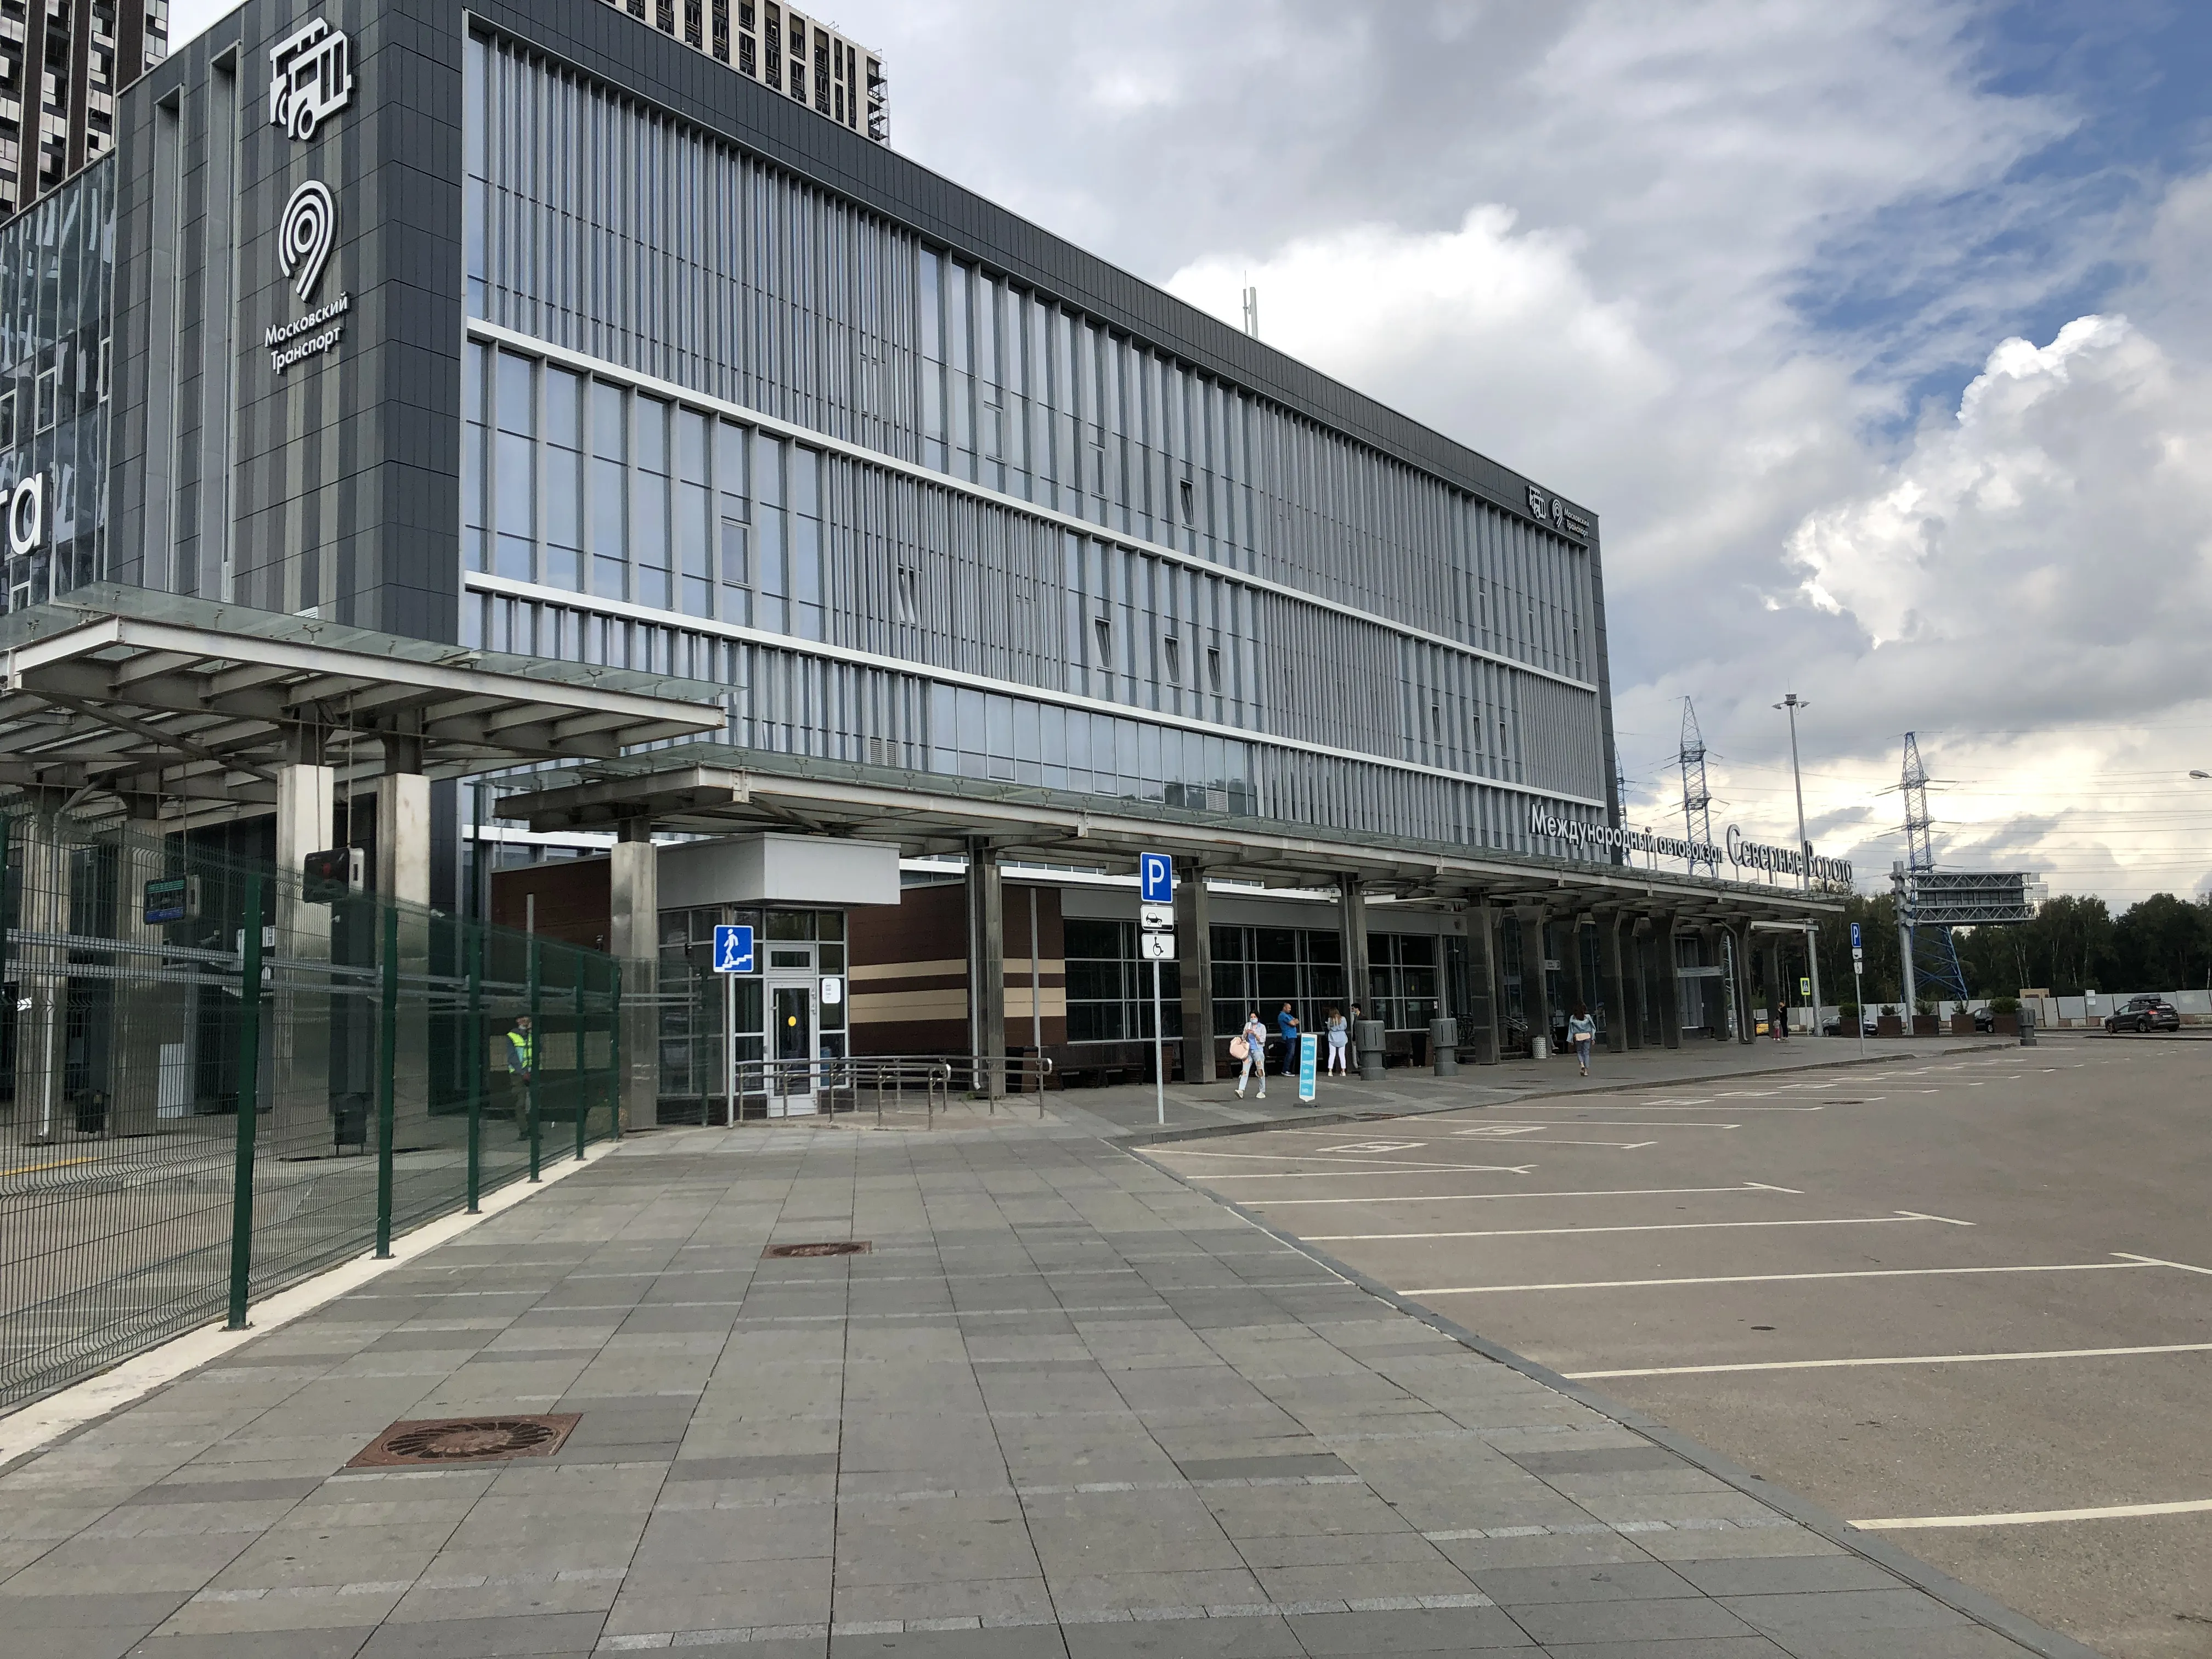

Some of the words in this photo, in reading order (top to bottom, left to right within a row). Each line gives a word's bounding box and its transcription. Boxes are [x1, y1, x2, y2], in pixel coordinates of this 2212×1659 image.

[265, 291, 348, 347] Московский
[270, 327, 340, 375] Транспорт
[1531, 804, 1656, 854] Международный
[1659, 836, 1723, 863] автовокзал
[1726, 823, 1804, 884] Северные
[1804, 840, 1853, 891] Ворота
[1148, 859, 1164, 896] P
[1853, 926, 1858, 944] P
